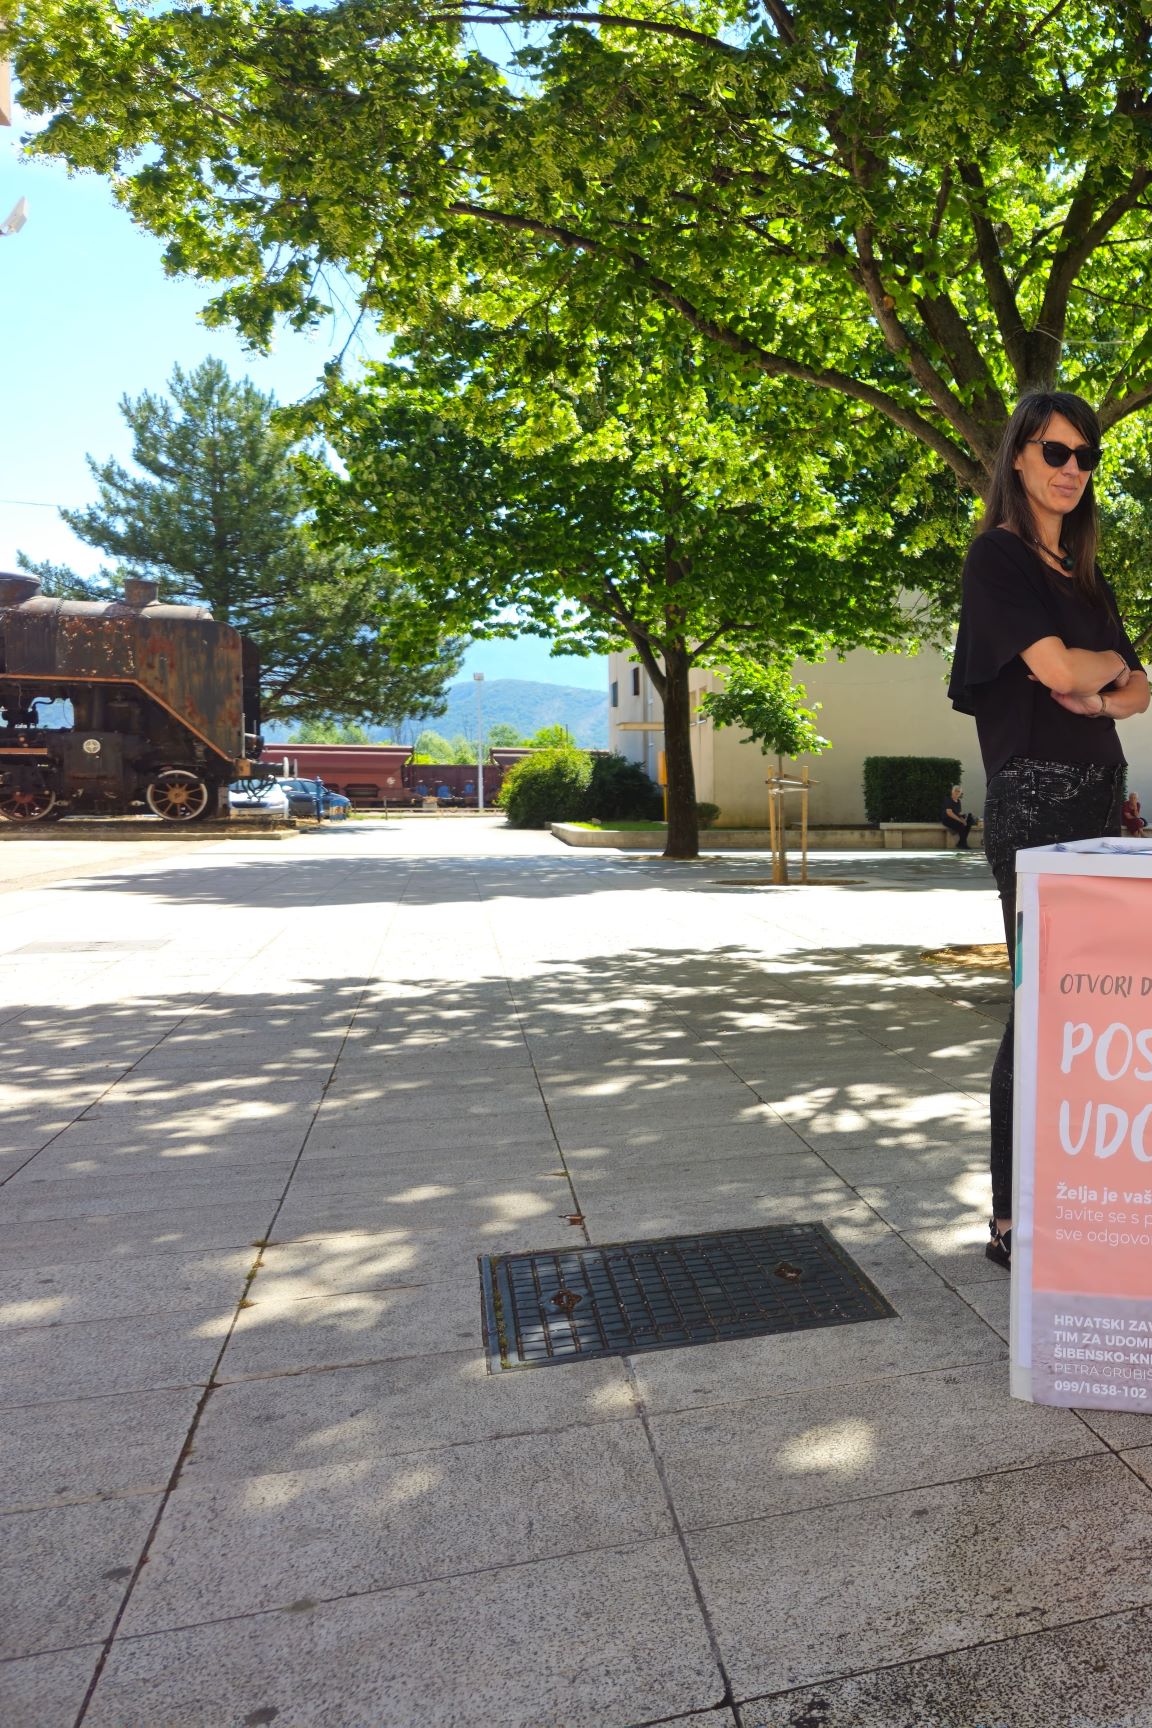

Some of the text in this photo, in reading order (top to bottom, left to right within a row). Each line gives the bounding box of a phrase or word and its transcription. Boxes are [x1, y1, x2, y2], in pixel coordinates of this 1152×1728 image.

[1059, 973, 1132, 998] OTVORI
[1056, 1183, 1098, 1205] Želja
[1101, 1187, 1119, 1205] je
[1055, 1206, 1104, 1223] Javite
[1108, 1211, 1127, 1224] se
[1130, 1212, 1140, 1224] s
[1055, 1228, 1083, 1241] sve
[1053, 1314, 1125, 1331] HRVATSKI
[1053, 1330, 1079, 1344] TIM
[1082, 1332, 1101, 1345] ZA
[1054, 1363, 1099, 1377] PETRA
[1054, 1379, 1147, 1400] 099/1638-102
